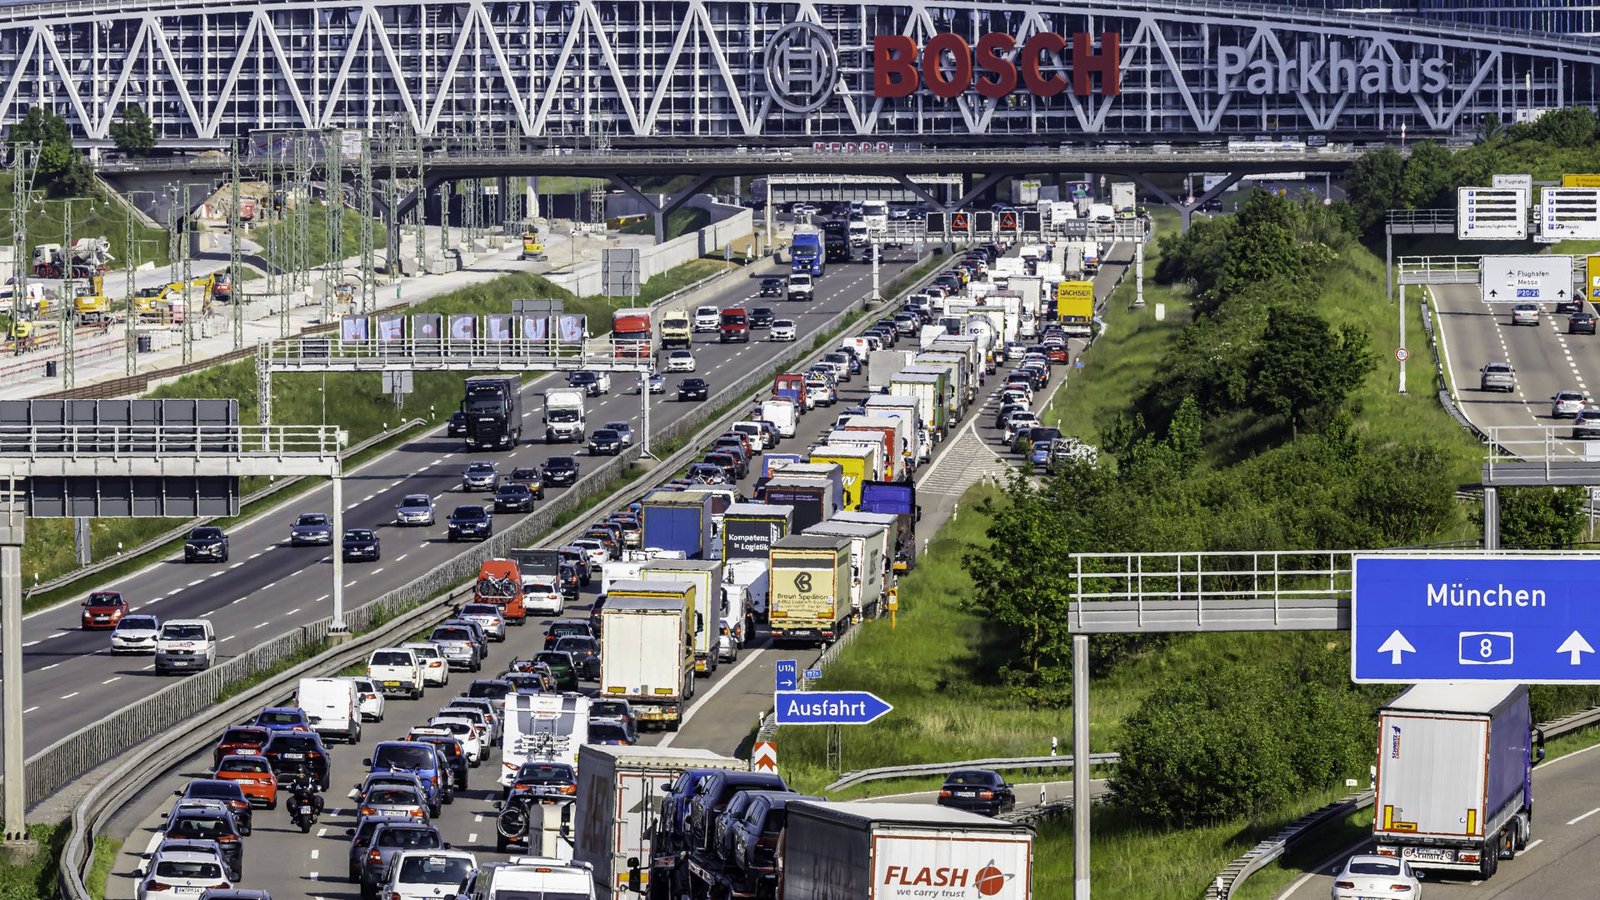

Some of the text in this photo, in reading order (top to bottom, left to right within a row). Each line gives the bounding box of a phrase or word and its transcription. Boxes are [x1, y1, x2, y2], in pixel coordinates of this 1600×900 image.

[874, 32, 1119, 97] BOSCH
[1217, 41, 1448, 95] Parkhaus
[1517, 270, 1550, 278] Flughafen
[729, 533, 769, 542] Kompetenz
[741, 543, 769, 552] Logistik
[1426, 583, 1546, 607] München
[1480, 638, 1493, 658] 8
[787, 699, 866, 716] Ausfahrt
[1413, 853, 1445, 861] SCHMITZ
[884, 865, 969, 888] FLASH
[914, 890, 939, 899] carry
[941, 889, 966, 898] trust
